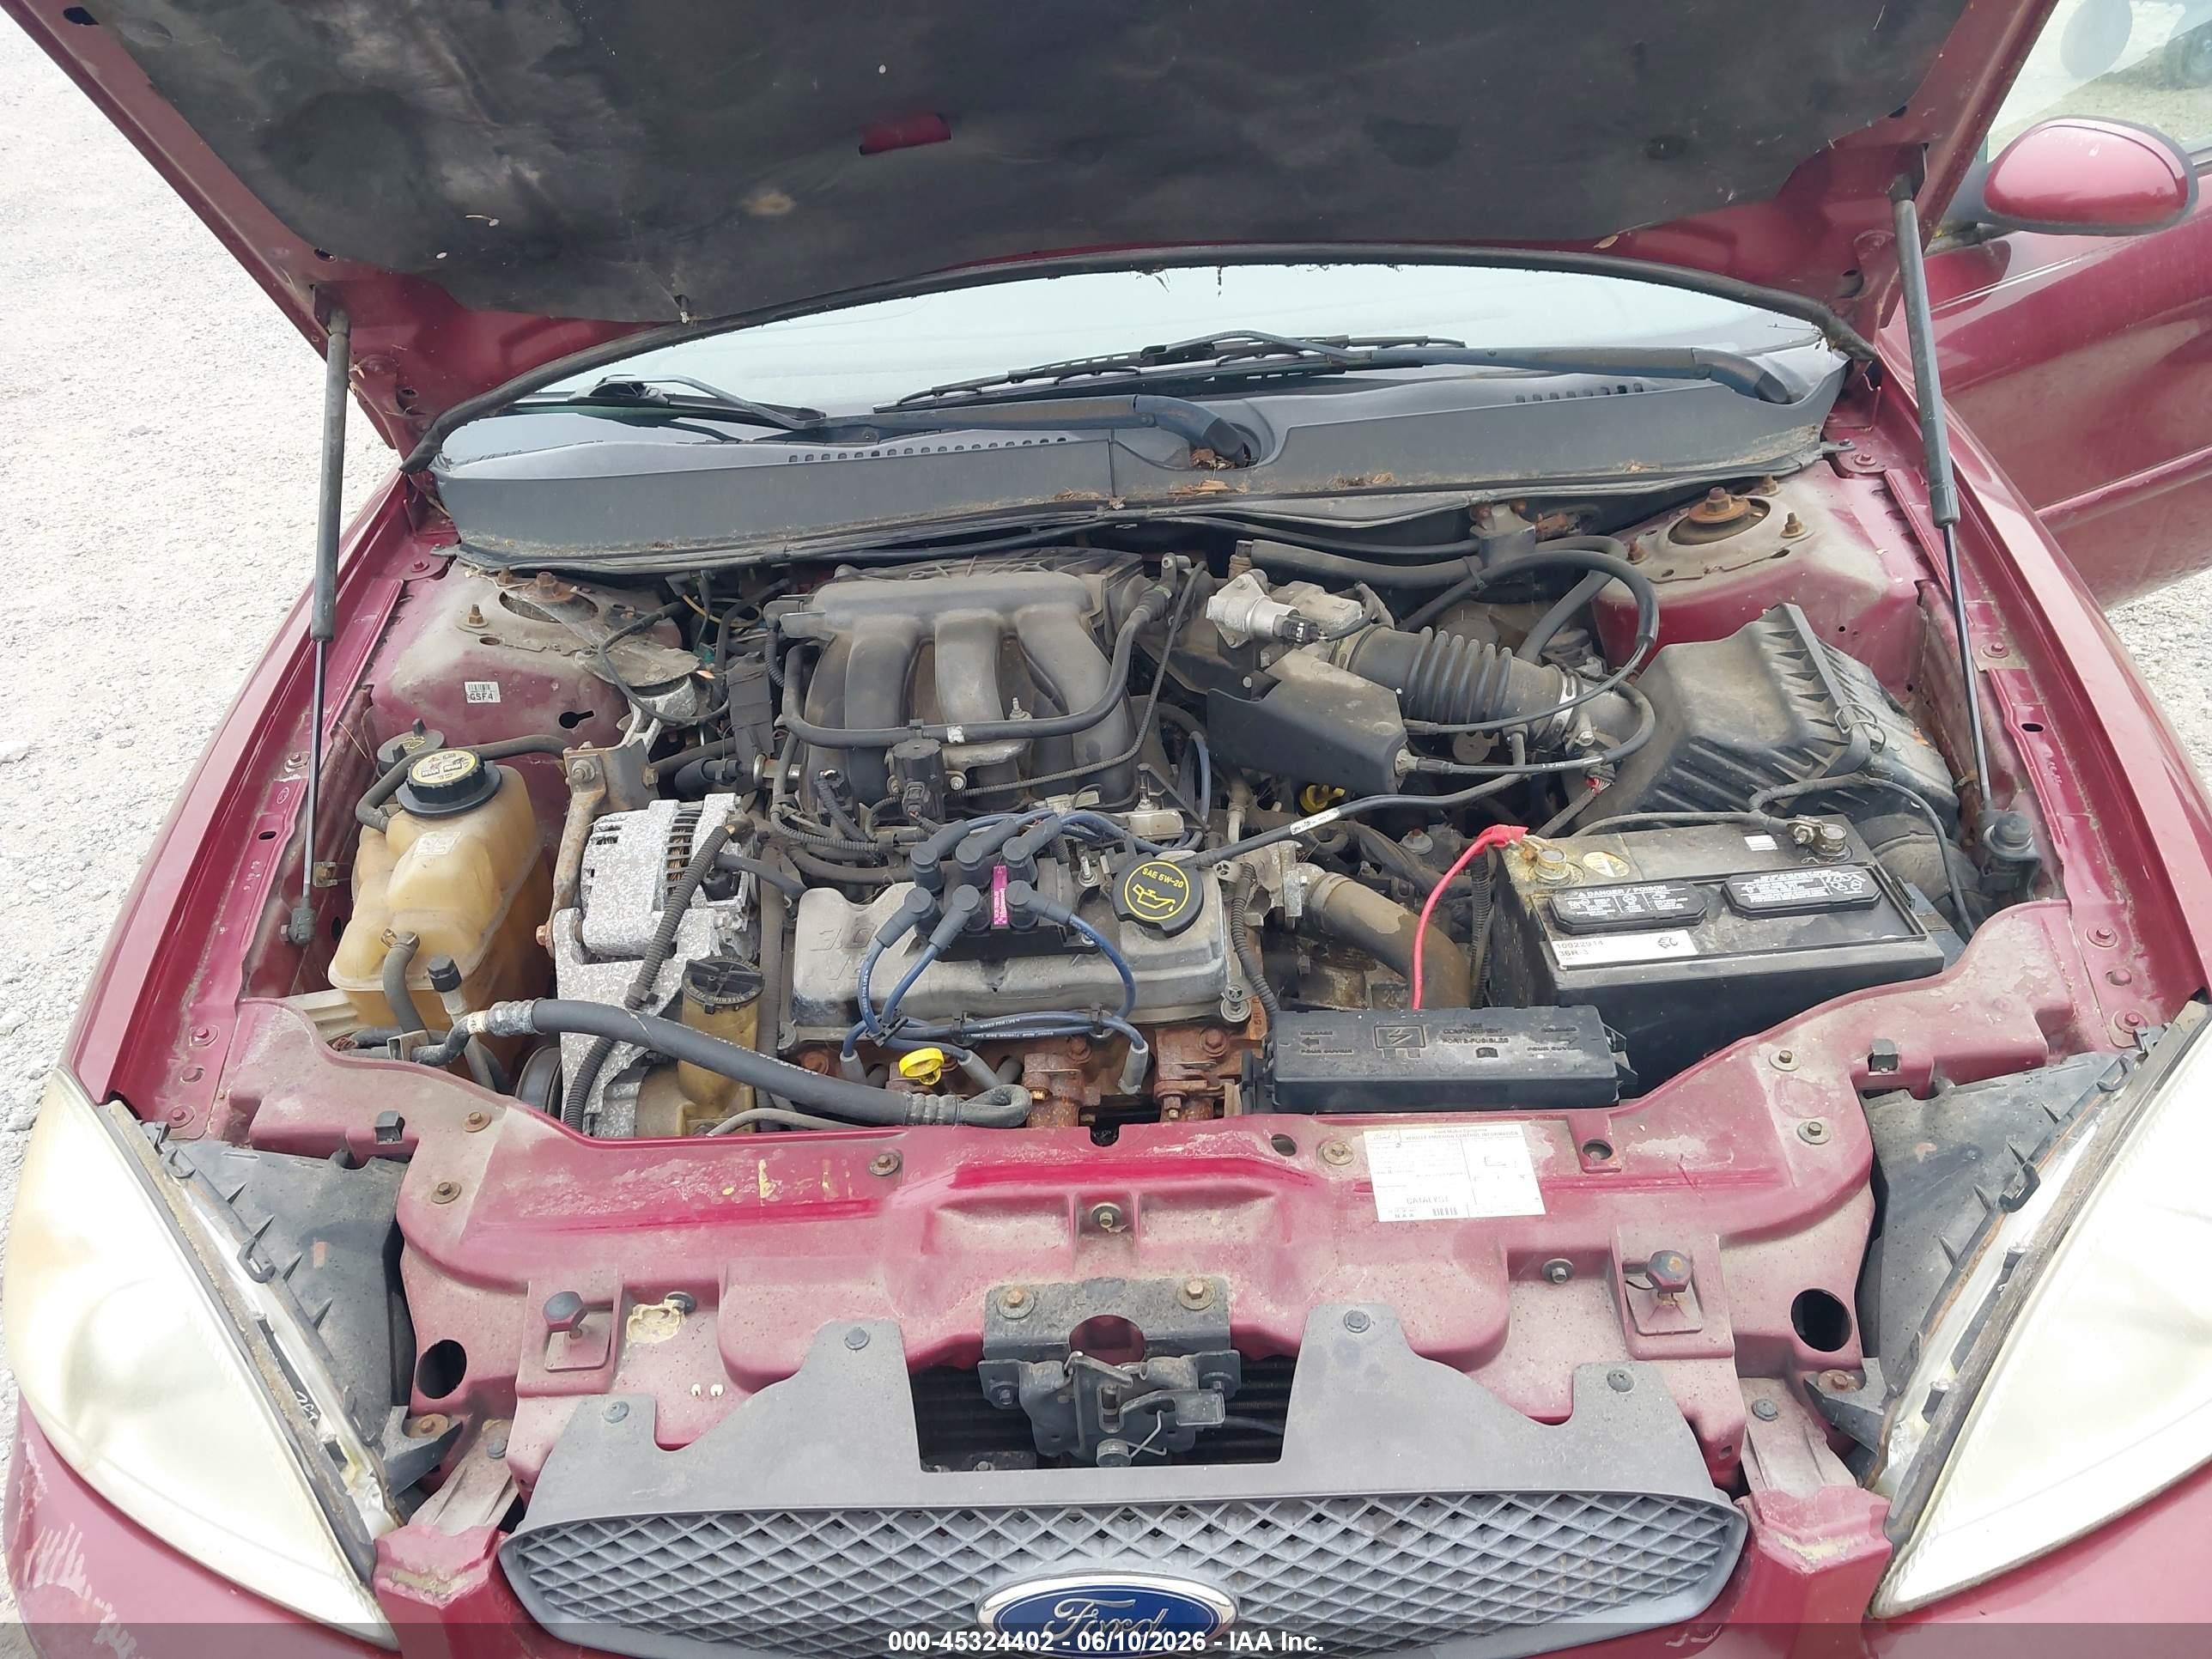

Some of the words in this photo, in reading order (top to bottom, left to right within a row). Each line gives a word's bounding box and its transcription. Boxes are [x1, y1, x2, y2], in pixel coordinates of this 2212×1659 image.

[1142, 867, 1158, 879] SAE
[1158, 873, 1184, 888] 5W-20
[1586, 888, 1625, 897] DANGER
[1407, 1194, 1449, 1205] CATALYST
[1043, 1597, 1169, 1641] Ford
